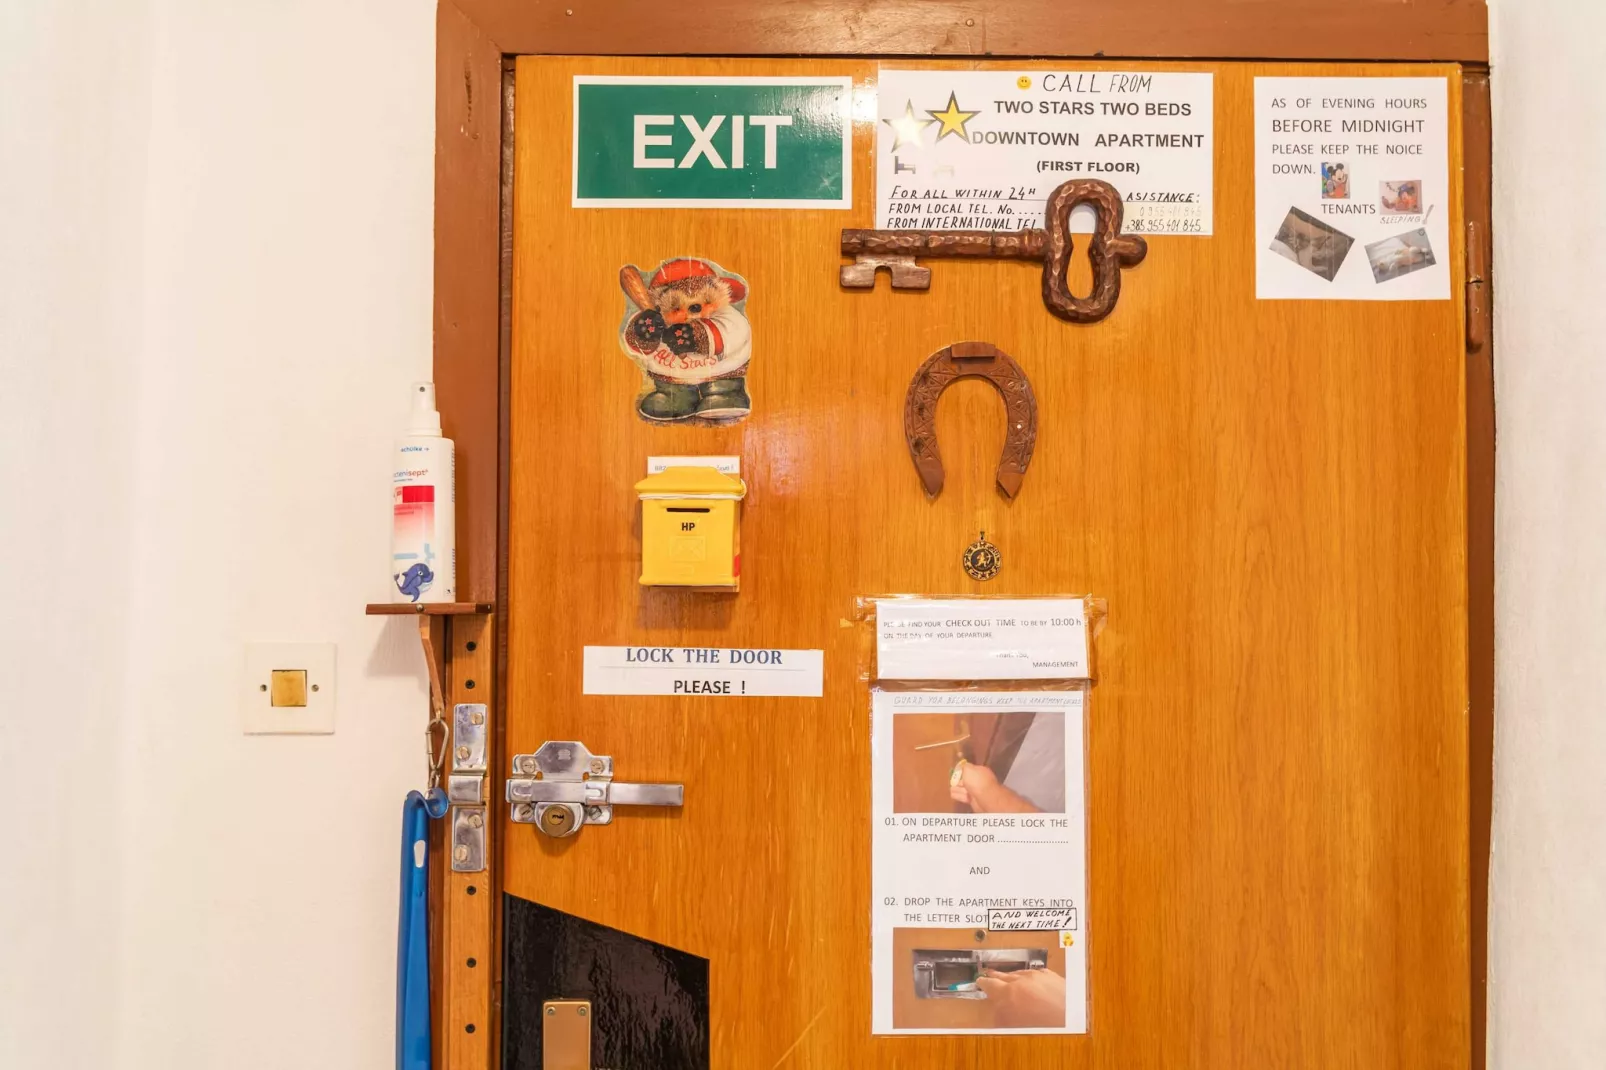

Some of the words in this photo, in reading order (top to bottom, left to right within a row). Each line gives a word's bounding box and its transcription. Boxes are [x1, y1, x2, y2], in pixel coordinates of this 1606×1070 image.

[1043, 74, 1101, 93] CALL
[1109, 74, 1152, 92] FROM
[994, 101, 1034, 115] TWO
[1039, 101, 1094, 115] STARS
[1100, 102, 1140, 116] TWO
[1145, 103, 1192, 116] BEDS
[1271, 98, 1286, 109] AS
[1296, 98, 1312, 109] OF
[1322, 98, 1375, 109] EVENING
[1385, 98, 1427, 109] HOURS
[1272, 119, 1332, 133] BEFORE
[1341, 119, 1425, 133] MIDNIGHT
[633, 115, 792, 169] EXIT
[972, 131, 1079, 146] DOWNTOWN
[1094, 134, 1204, 148] APARTMENT
[1272, 144, 1314, 155] PLEASE
[1321, 144, 1349, 155] KEEP
[1356, 144, 1379, 155] THE
[1386, 144, 1423, 155] NOICE
[1037, 161, 1082, 173] (FIRST
[1087, 161, 1140, 174] FLOOR)
[1272, 163, 1316, 175] DOWN.
[923, 189, 948, 199] ALL
[955, 189, 1002, 199] WITHIN
[888, 203, 921, 214] FROM
[926, 203, 963, 214] LOCAL
[1321, 204, 1376, 215] TENANTS
[887, 217, 918, 229] FROM
[921, 216, 1012, 230] INTERNATIONAL
[654, 349, 676, 369] All
[679, 356, 717, 370] Stars
[681, 522, 696, 531] HP
[946, 619, 972, 627] CHECK
[974, 619, 991, 627] OUT
[996, 619, 1016, 627] TIME
[1050, 618, 1074, 626] 10:00
[626, 648, 674, 663] LOCK
[683, 648, 720, 664] THE
[729, 650, 783, 665] DOOR
[673, 680, 731, 694] PLEASE
[741, 680, 746, 694] !
[894, 696, 923, 704] GUARD
[884, 817, 899, 826] 01.
[902, 817, 917, 827] ON
[922, 818, 978, 827] DEPARTURE
[982, 818, 1016, 828] PLEASE
[1021, 818, 1045, 828] LOCK
[1050, 819, 1068, 828] THE
[903, 833, 962, 843] APARTMENT
[967, 834, 995, 843] DOOR
[969, 866, 991, 875] AND
[884, 897, 899, 906] 02.
[904, 897, 931, 907] DROP
[936, 898, 954, 907] THE
[959, 898, 1018, 907] APARTMENT
[1022, 898, 1045, 908] KEYS
[1050, 899, 1073, 908] INTO
[904, 913, 922, 922] THE
[927, 914, 960, 923] LETTER
[965, 914, 988, 923] SLOT
[992, 911, 1021, 920] AND
[1026, 909, 1071, 918] WELCOME
[991, 921, 1006, 929] THE
[1008, 920, 1033, 929] NEXT
